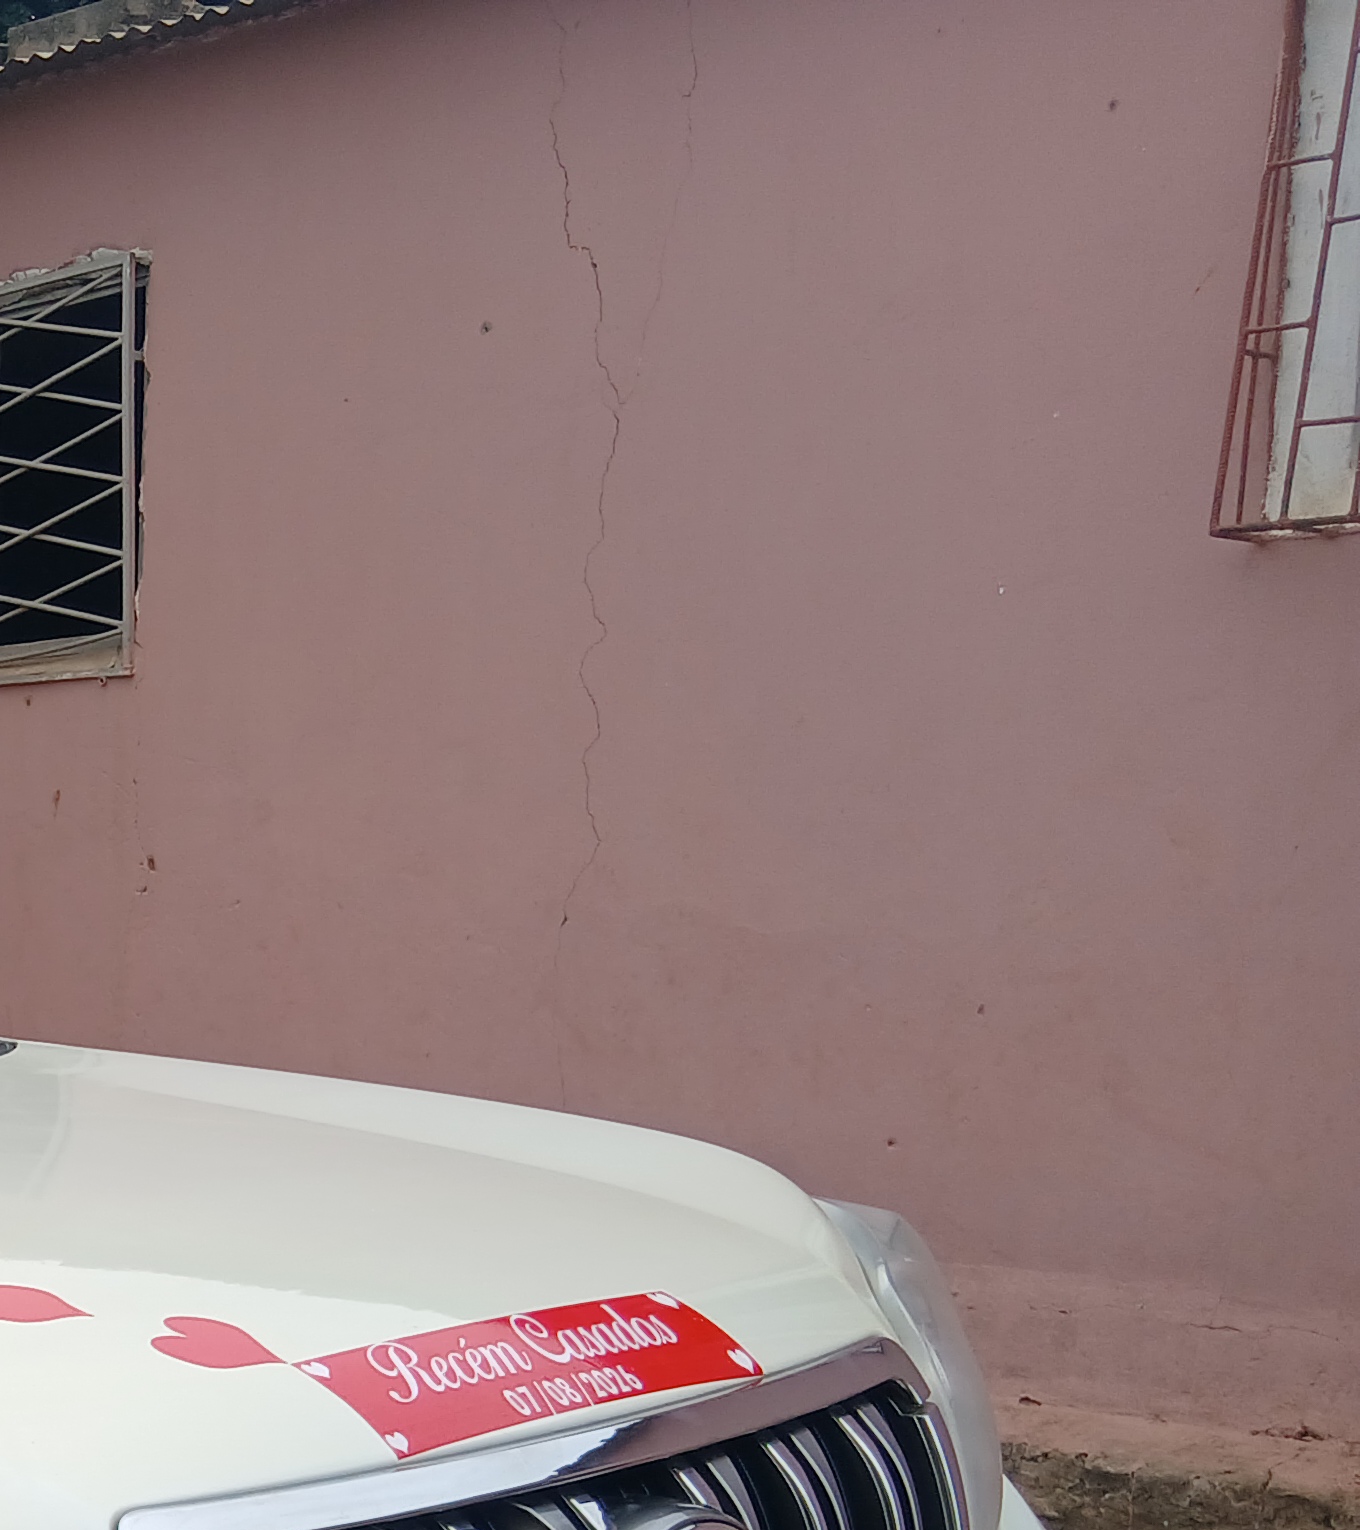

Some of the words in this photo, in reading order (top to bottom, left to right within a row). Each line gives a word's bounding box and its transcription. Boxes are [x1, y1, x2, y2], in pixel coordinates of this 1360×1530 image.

[366, 1337, 532, 1404] Recém
[509, 1303, 679, 1364] Casados
[502, 1363, 644, 1416] 07/08/2026
